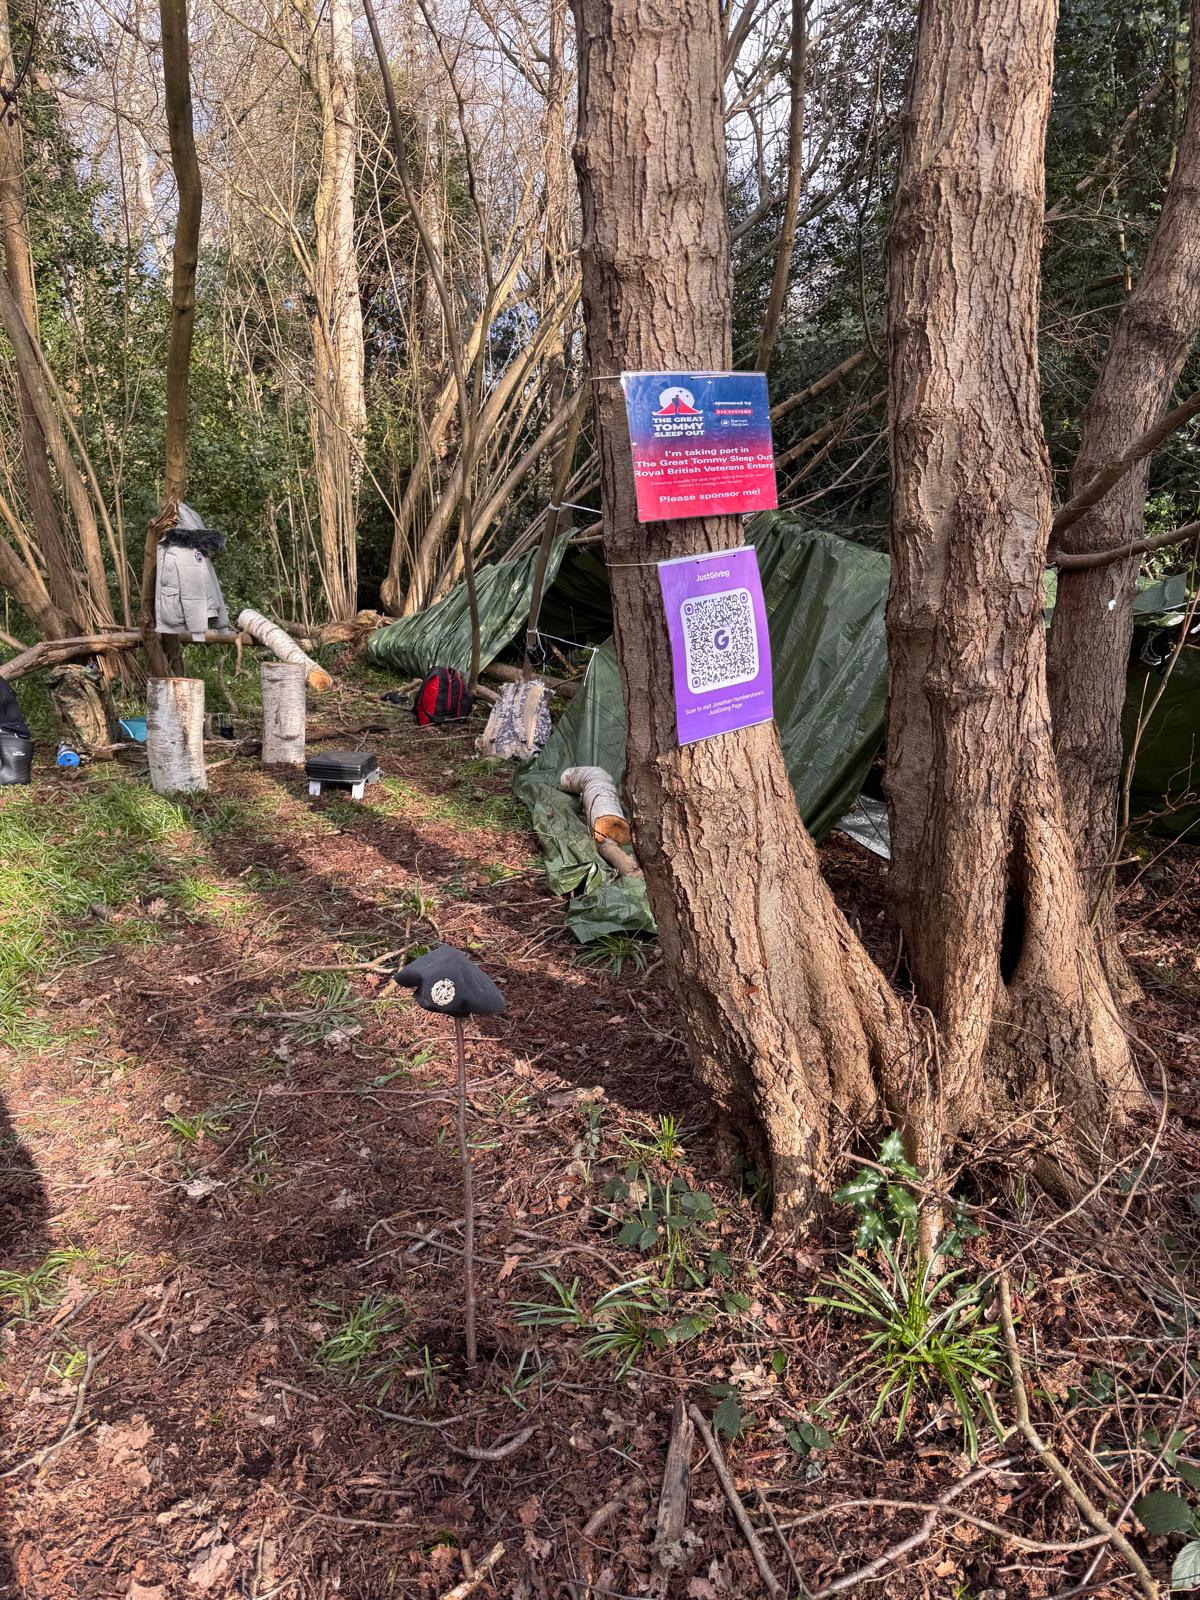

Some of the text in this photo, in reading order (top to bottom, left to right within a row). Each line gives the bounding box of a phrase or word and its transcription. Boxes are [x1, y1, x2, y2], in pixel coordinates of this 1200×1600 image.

[653, 422, 704, 432] TOMMY
[654, 430, 683, 438] SLEEP
[685, 448, 717, 456] taking
[719, 447, 739, 456] part
[659, 459, 688, 467] Great
[690, 456, 727, 465] Tommy
[730, 454, 755, 462] Sleep
[756, 453, 774, 461] Out
[634, 469, 664, 478] Royal
[667, 466, 701, 475] British
[703, 464, 745, 473] Veterans
[659, 488, 761, 503] Please sponsor me!
[696, 570, 730, 582] JustGiving
[685, 707, 697, 715] Scan
